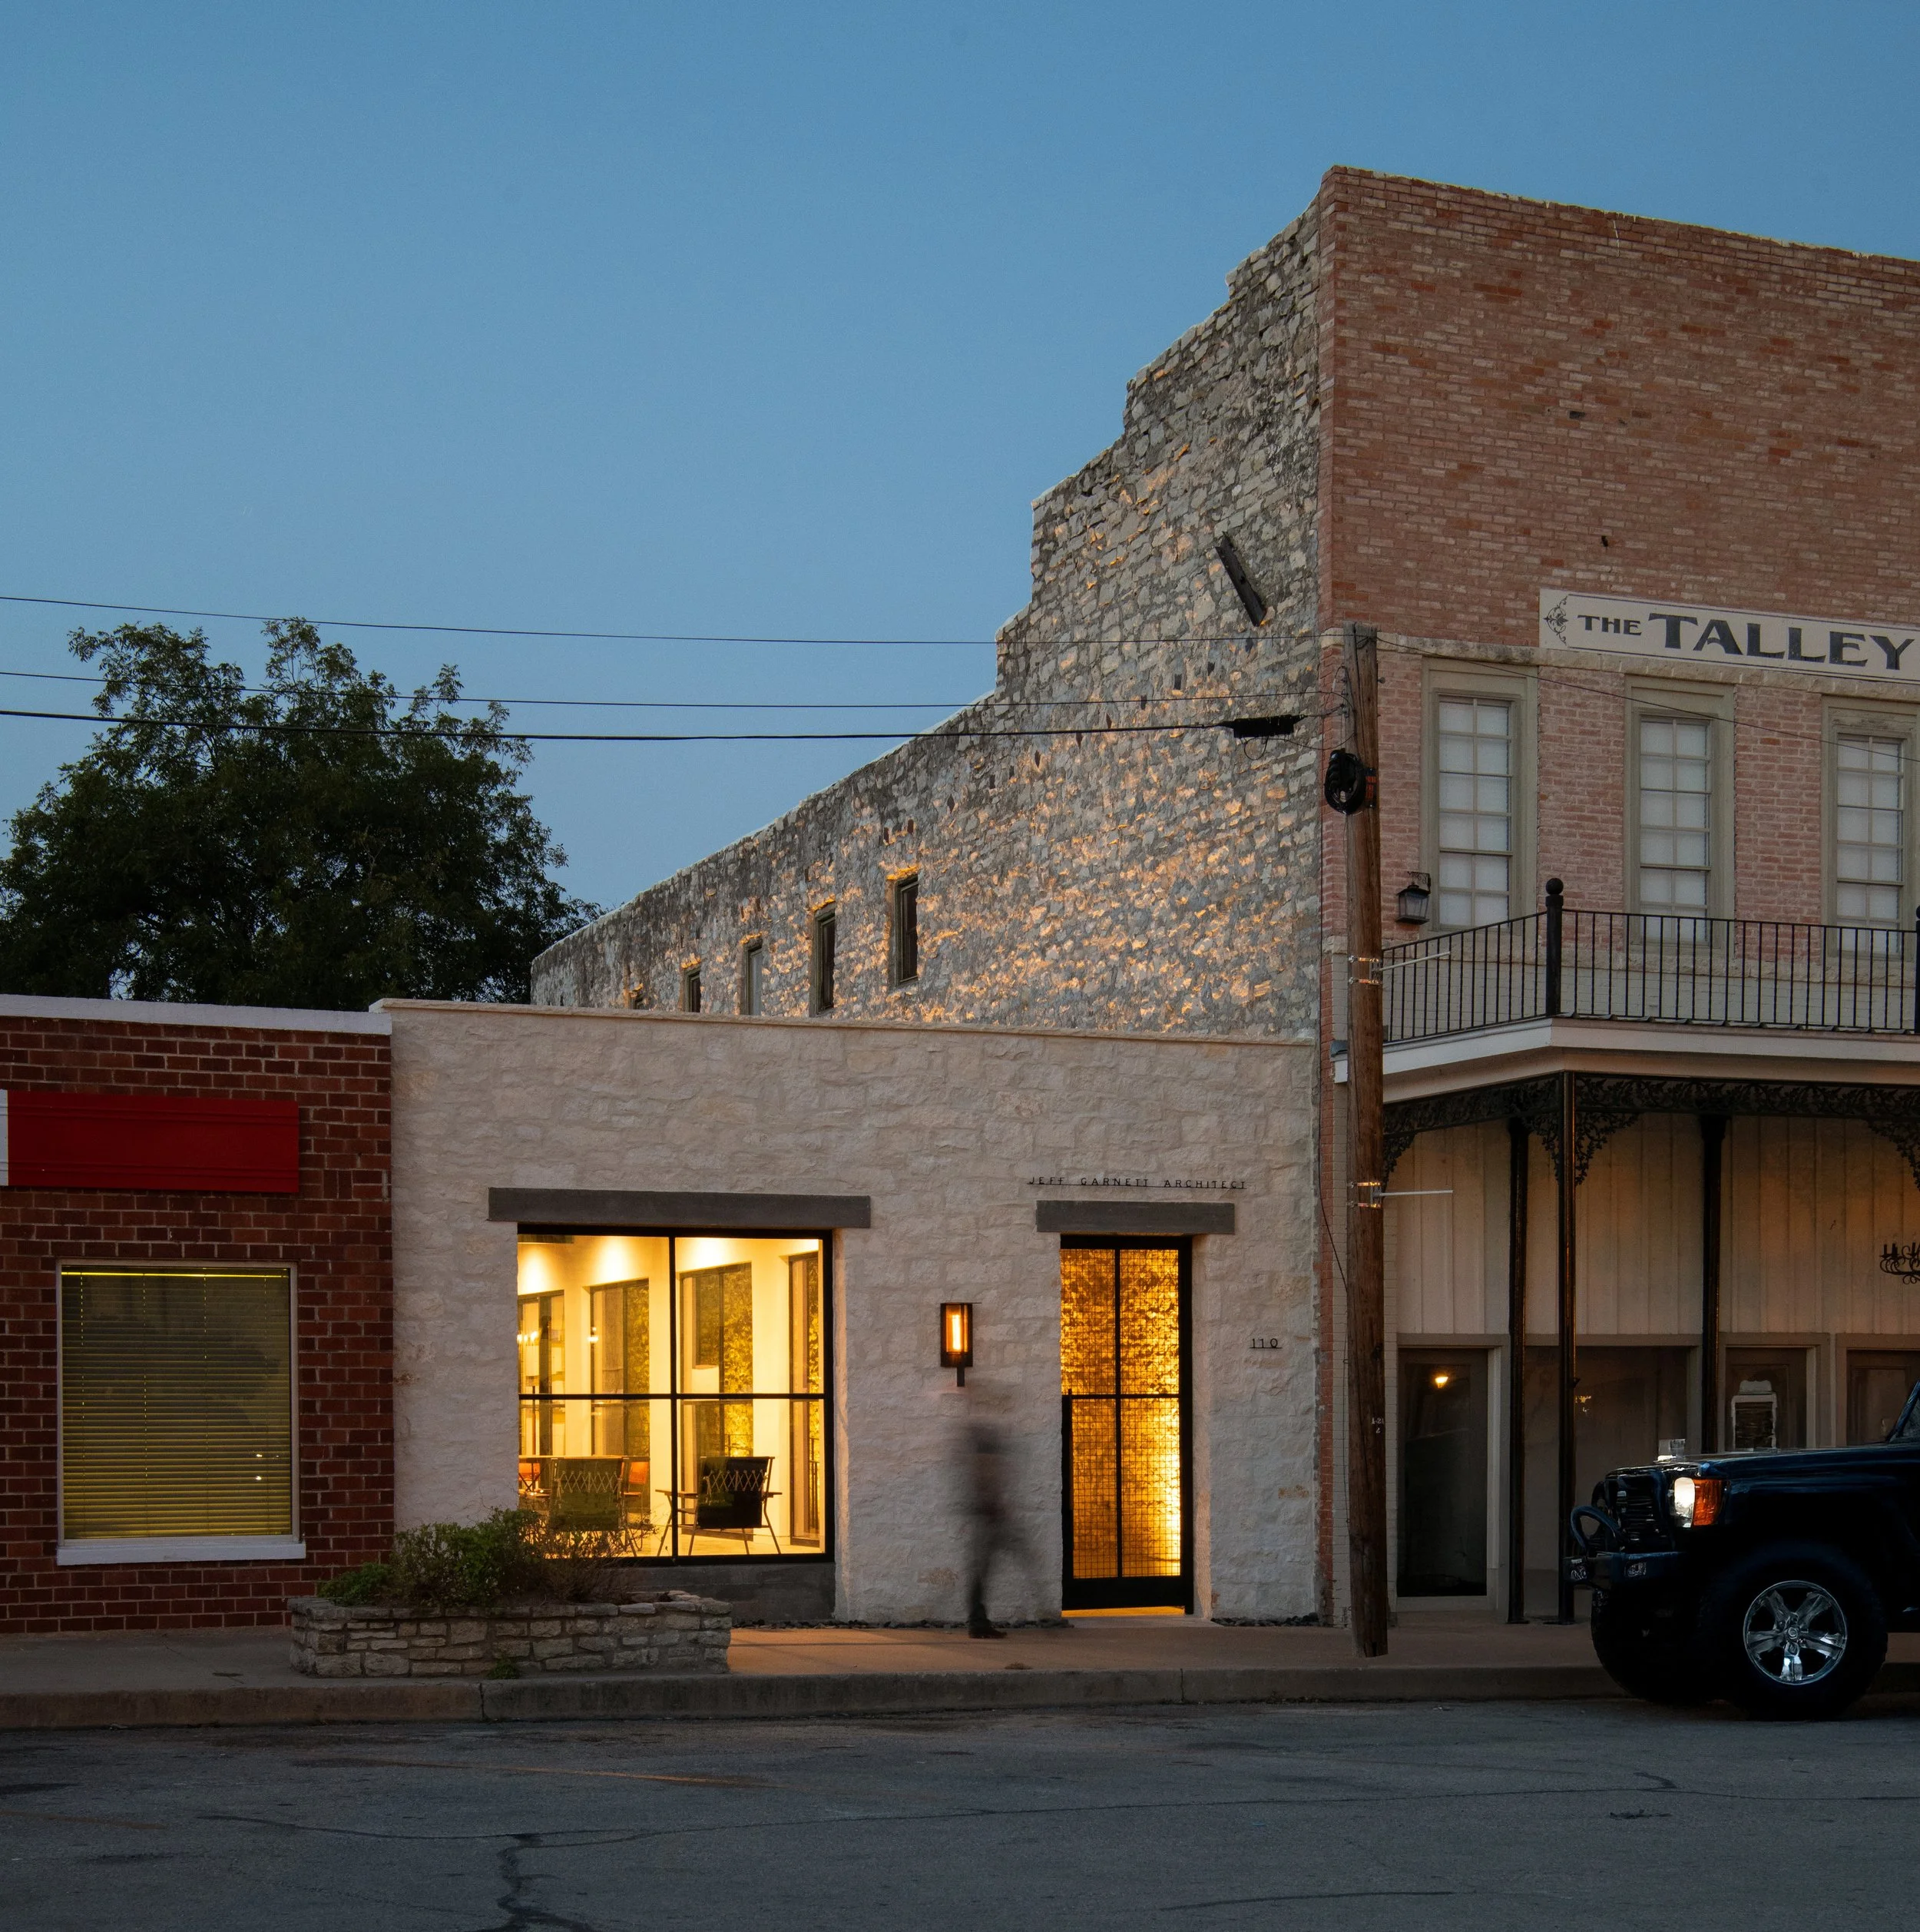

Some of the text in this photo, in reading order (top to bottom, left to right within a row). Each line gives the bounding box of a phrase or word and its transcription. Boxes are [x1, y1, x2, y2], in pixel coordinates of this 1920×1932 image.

[1577, 612, 1915, 671] THE TALLEY
[1028, 1176, 1246, 1190] JEFF GARNETT ARCHITECT
[1252, 1337, 1278, 1349] 110
